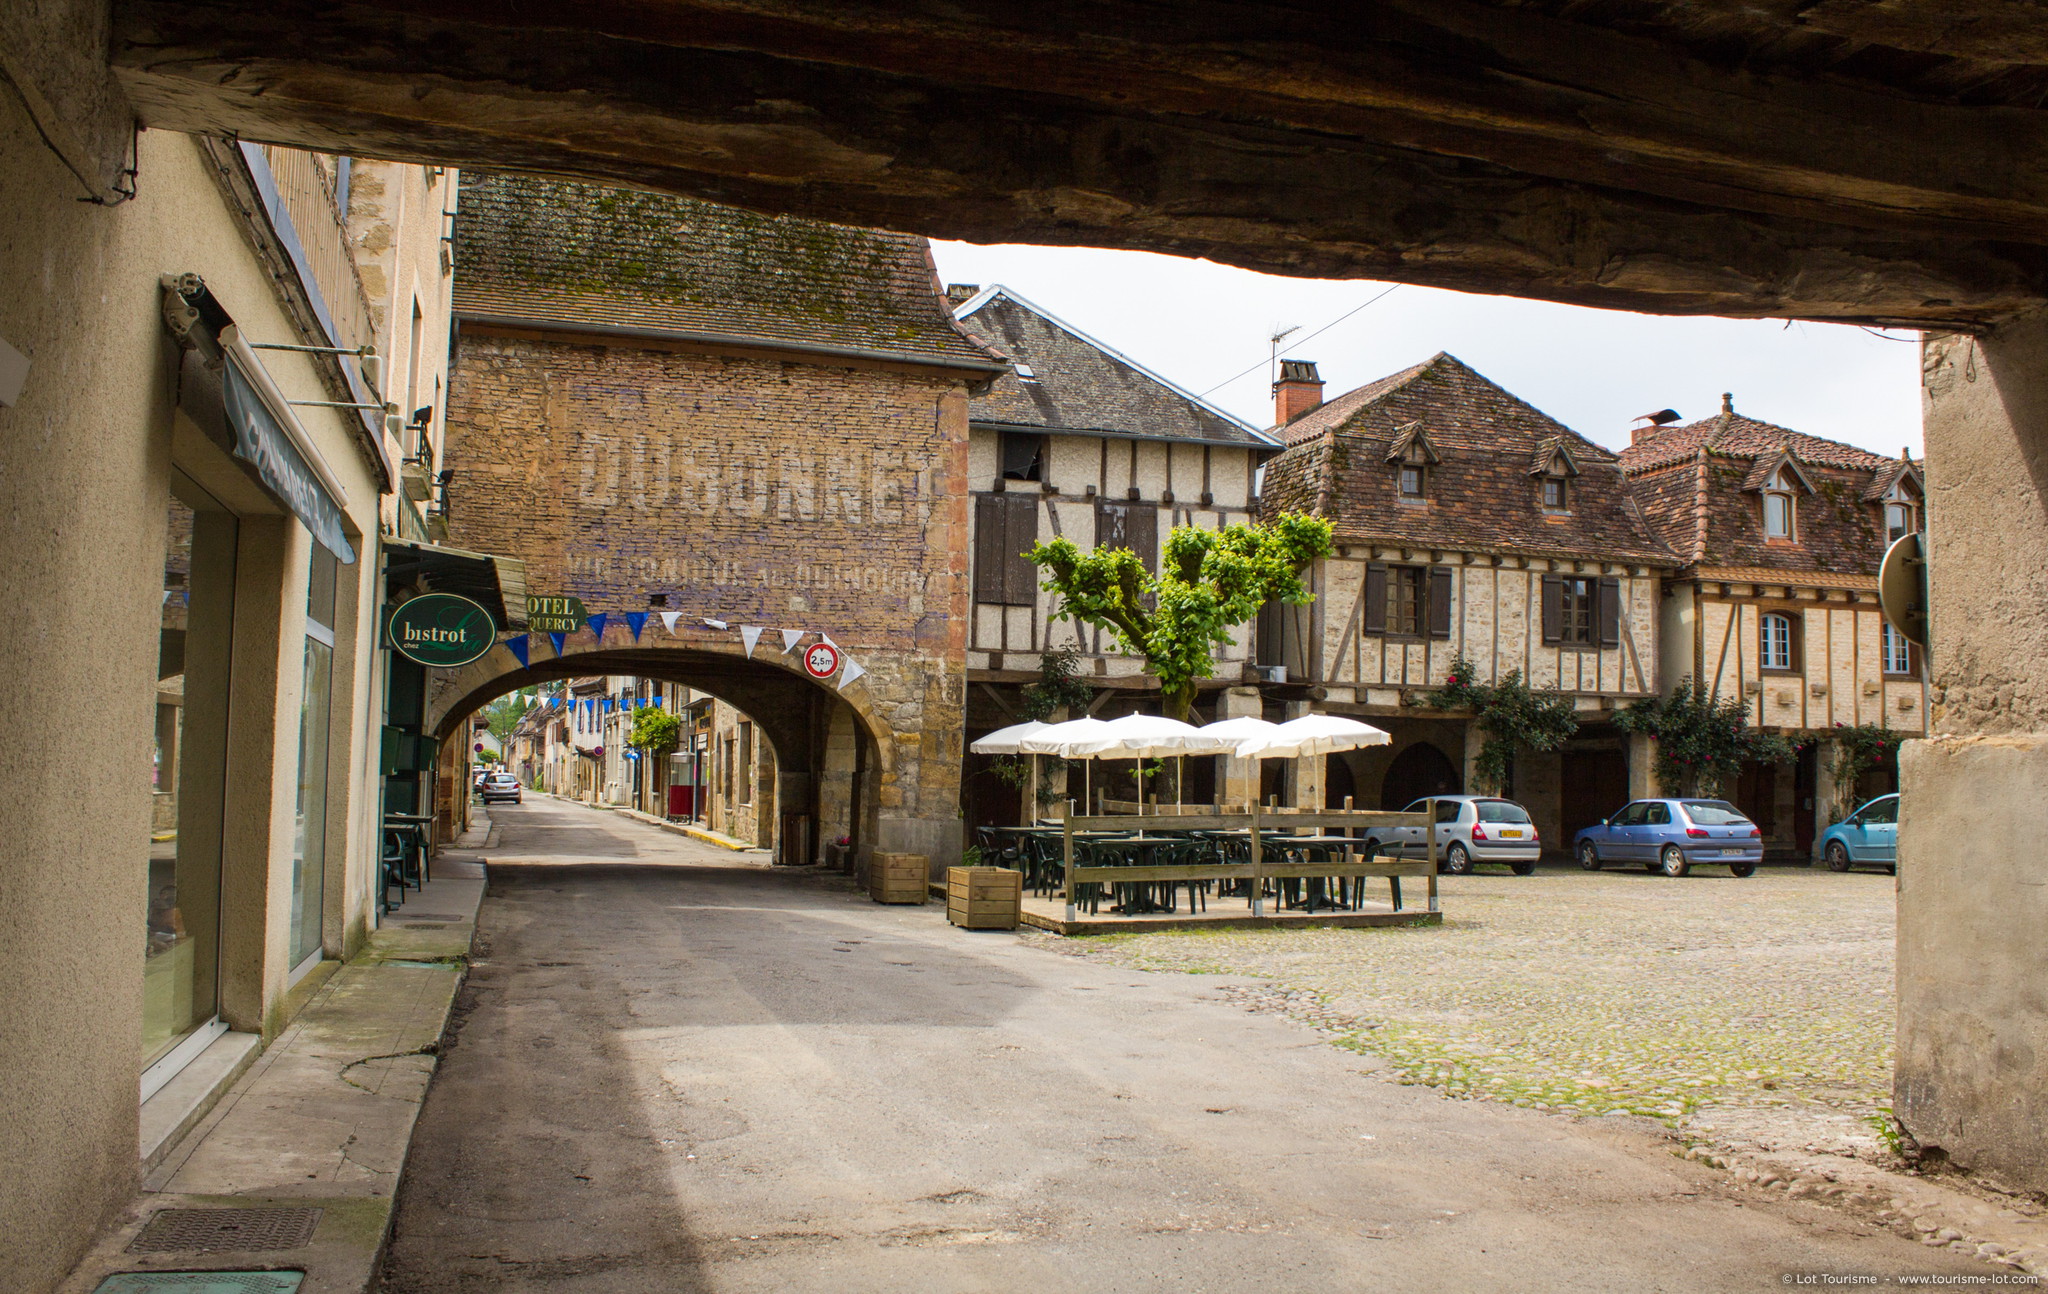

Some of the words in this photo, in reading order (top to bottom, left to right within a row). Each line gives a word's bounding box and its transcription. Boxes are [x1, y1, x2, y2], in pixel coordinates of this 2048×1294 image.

[578, 430, 943, 529] DUBONNET
[527, 597, 574, 615] OTEL
[404, 621, 467, 642] bistrot
[529, 617, 578, 632] QUERCY
